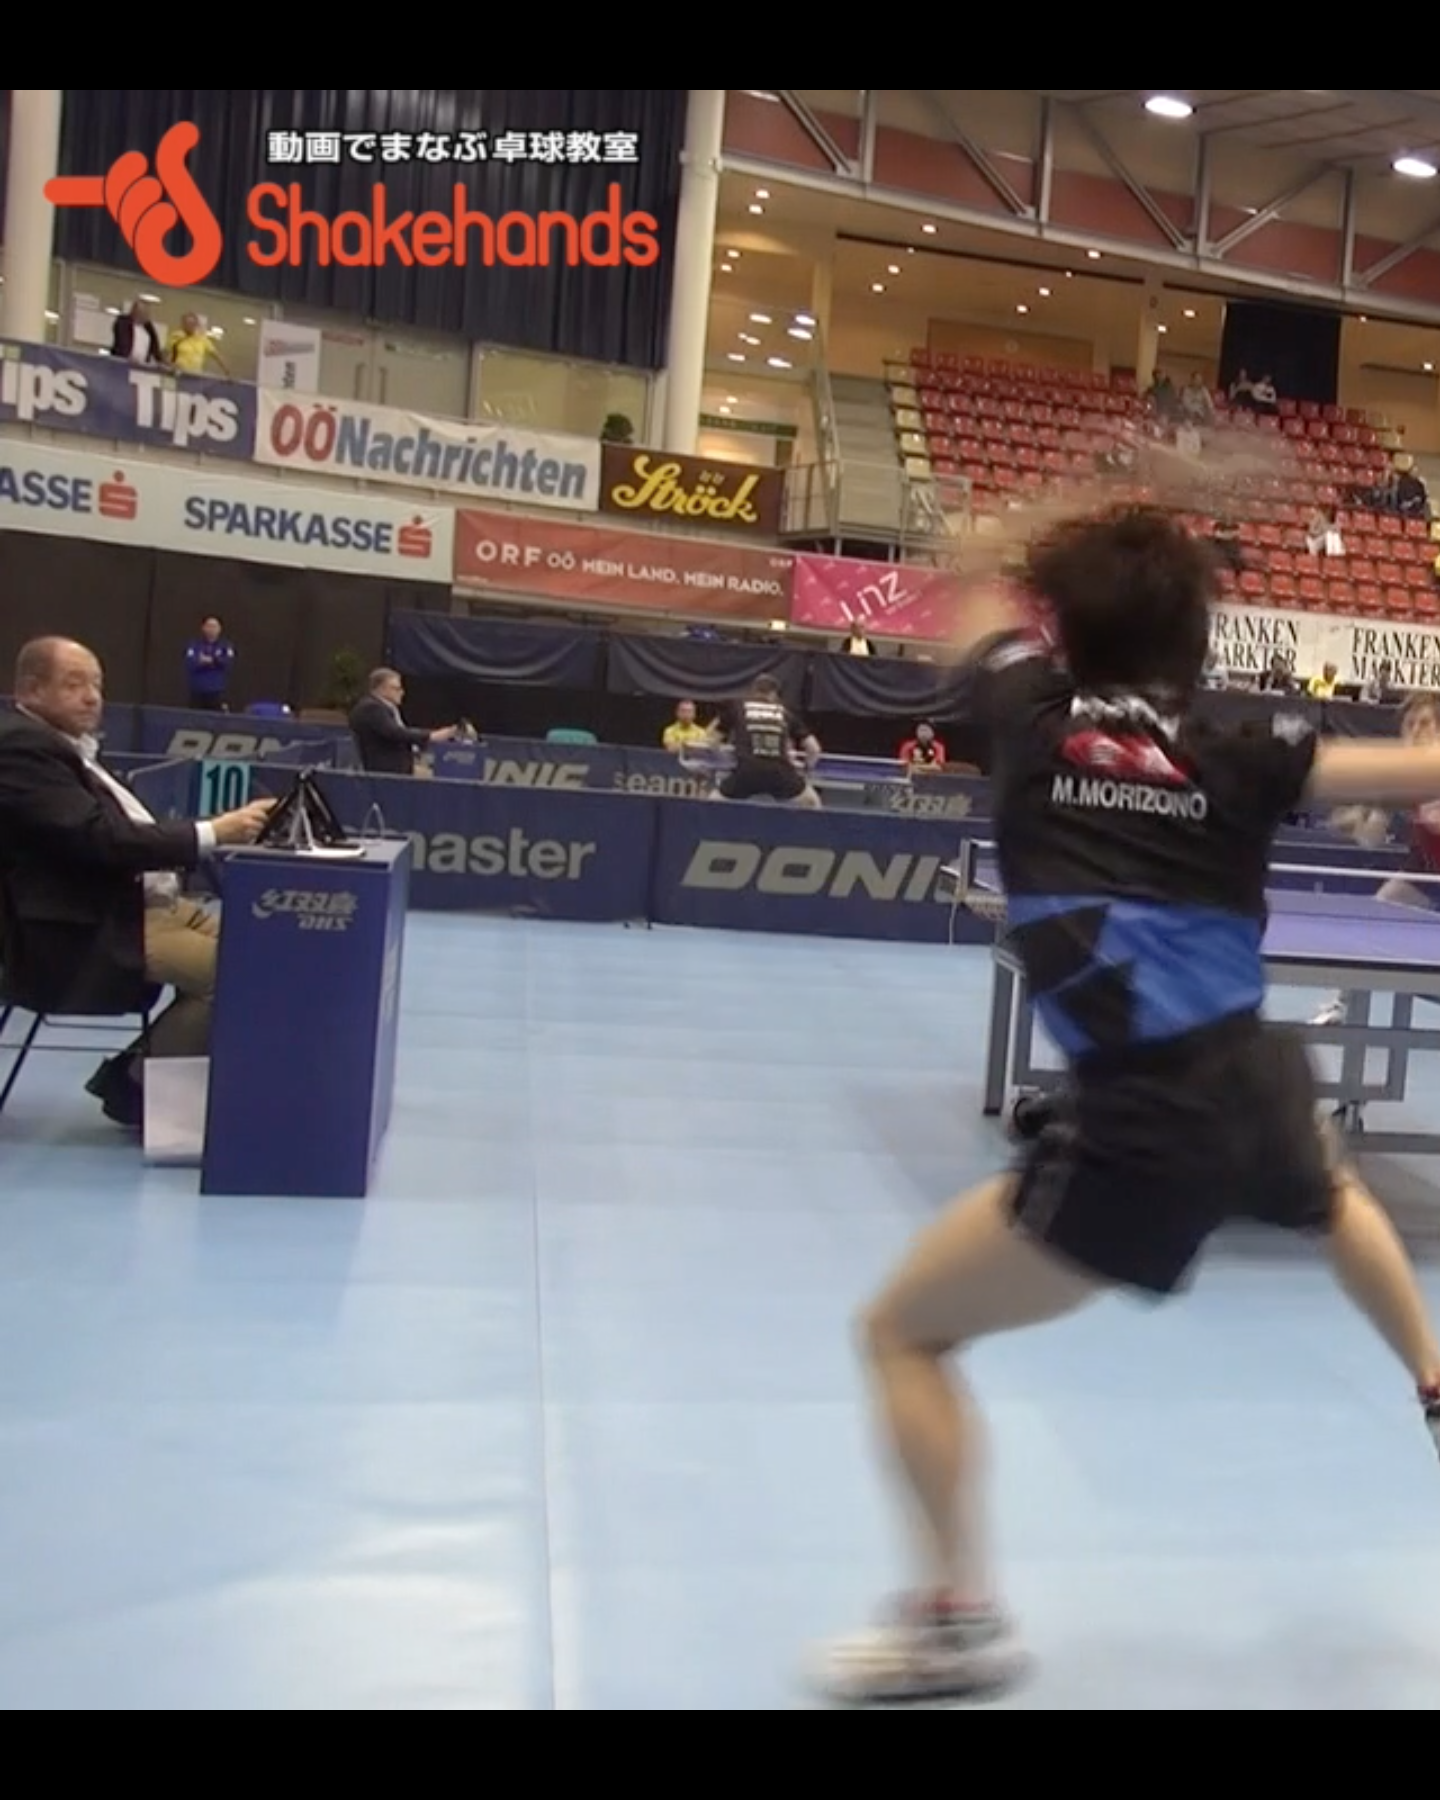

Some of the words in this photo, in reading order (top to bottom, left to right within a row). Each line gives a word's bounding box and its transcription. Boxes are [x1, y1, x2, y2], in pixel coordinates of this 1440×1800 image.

[0, 347, 88, 420] ips
[129, 369, 238, 447] Tips
[0, 467, 92, 513] ASSE
[612, 455, 757, 522] Ströck
[184, 497, 393, 553] SPARKASSE
[476, 540, 541, 567] ORF
[582, 560, 624, 578] MEIN
[627, 562, 680, 584] LAND.
[683, 570, 724, 588] MEIN
[728, 576, 784, 597] RADIO.
[1215, 612, 1300, 645] RANKEN
[206, 765, 245, 817] 10
[1052, 774, 1207, 820] M.MORIZONO
[411, 827, 596, 881] aster
